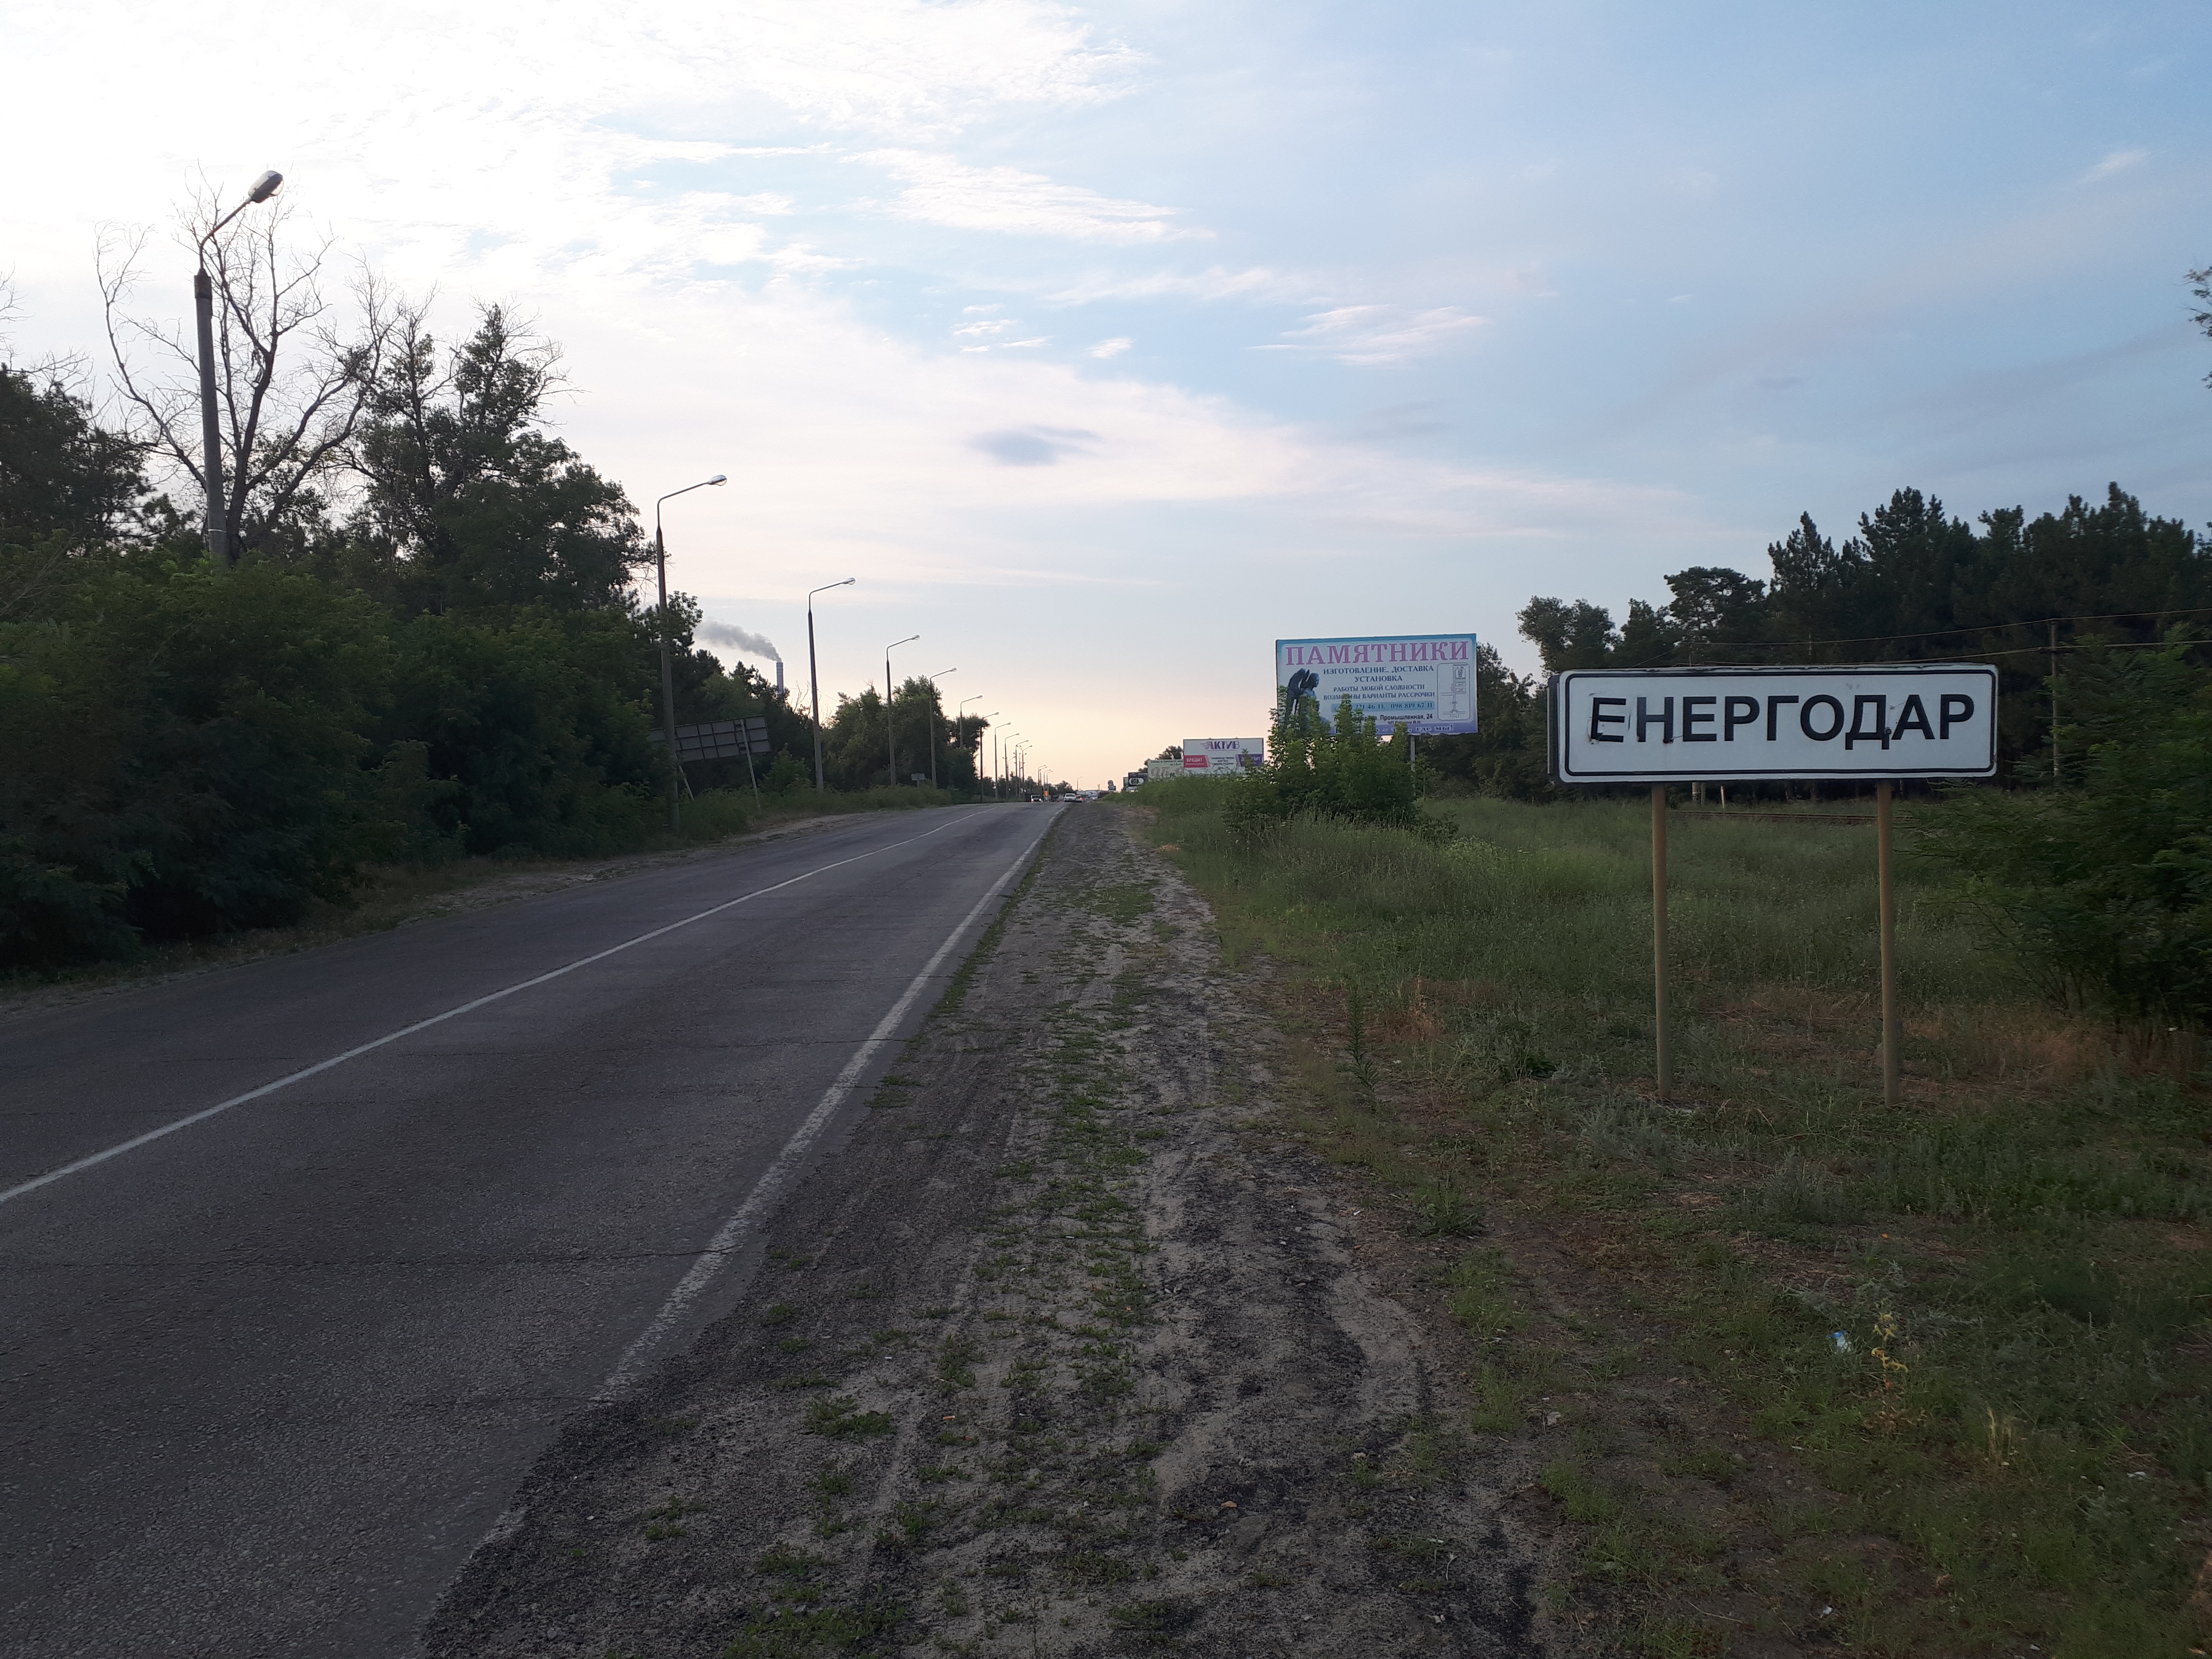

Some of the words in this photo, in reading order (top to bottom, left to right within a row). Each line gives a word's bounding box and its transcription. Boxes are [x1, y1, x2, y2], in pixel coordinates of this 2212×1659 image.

[1286, 641, 1468, 665] ПАМЯТНИКИ
[1392, 665, 1434, 673] ДОСТАВКА
[1590, 694, 1974, 750] ЕНЕРГОДАР
[1205, 741, 1239, 749] АКТИВ
